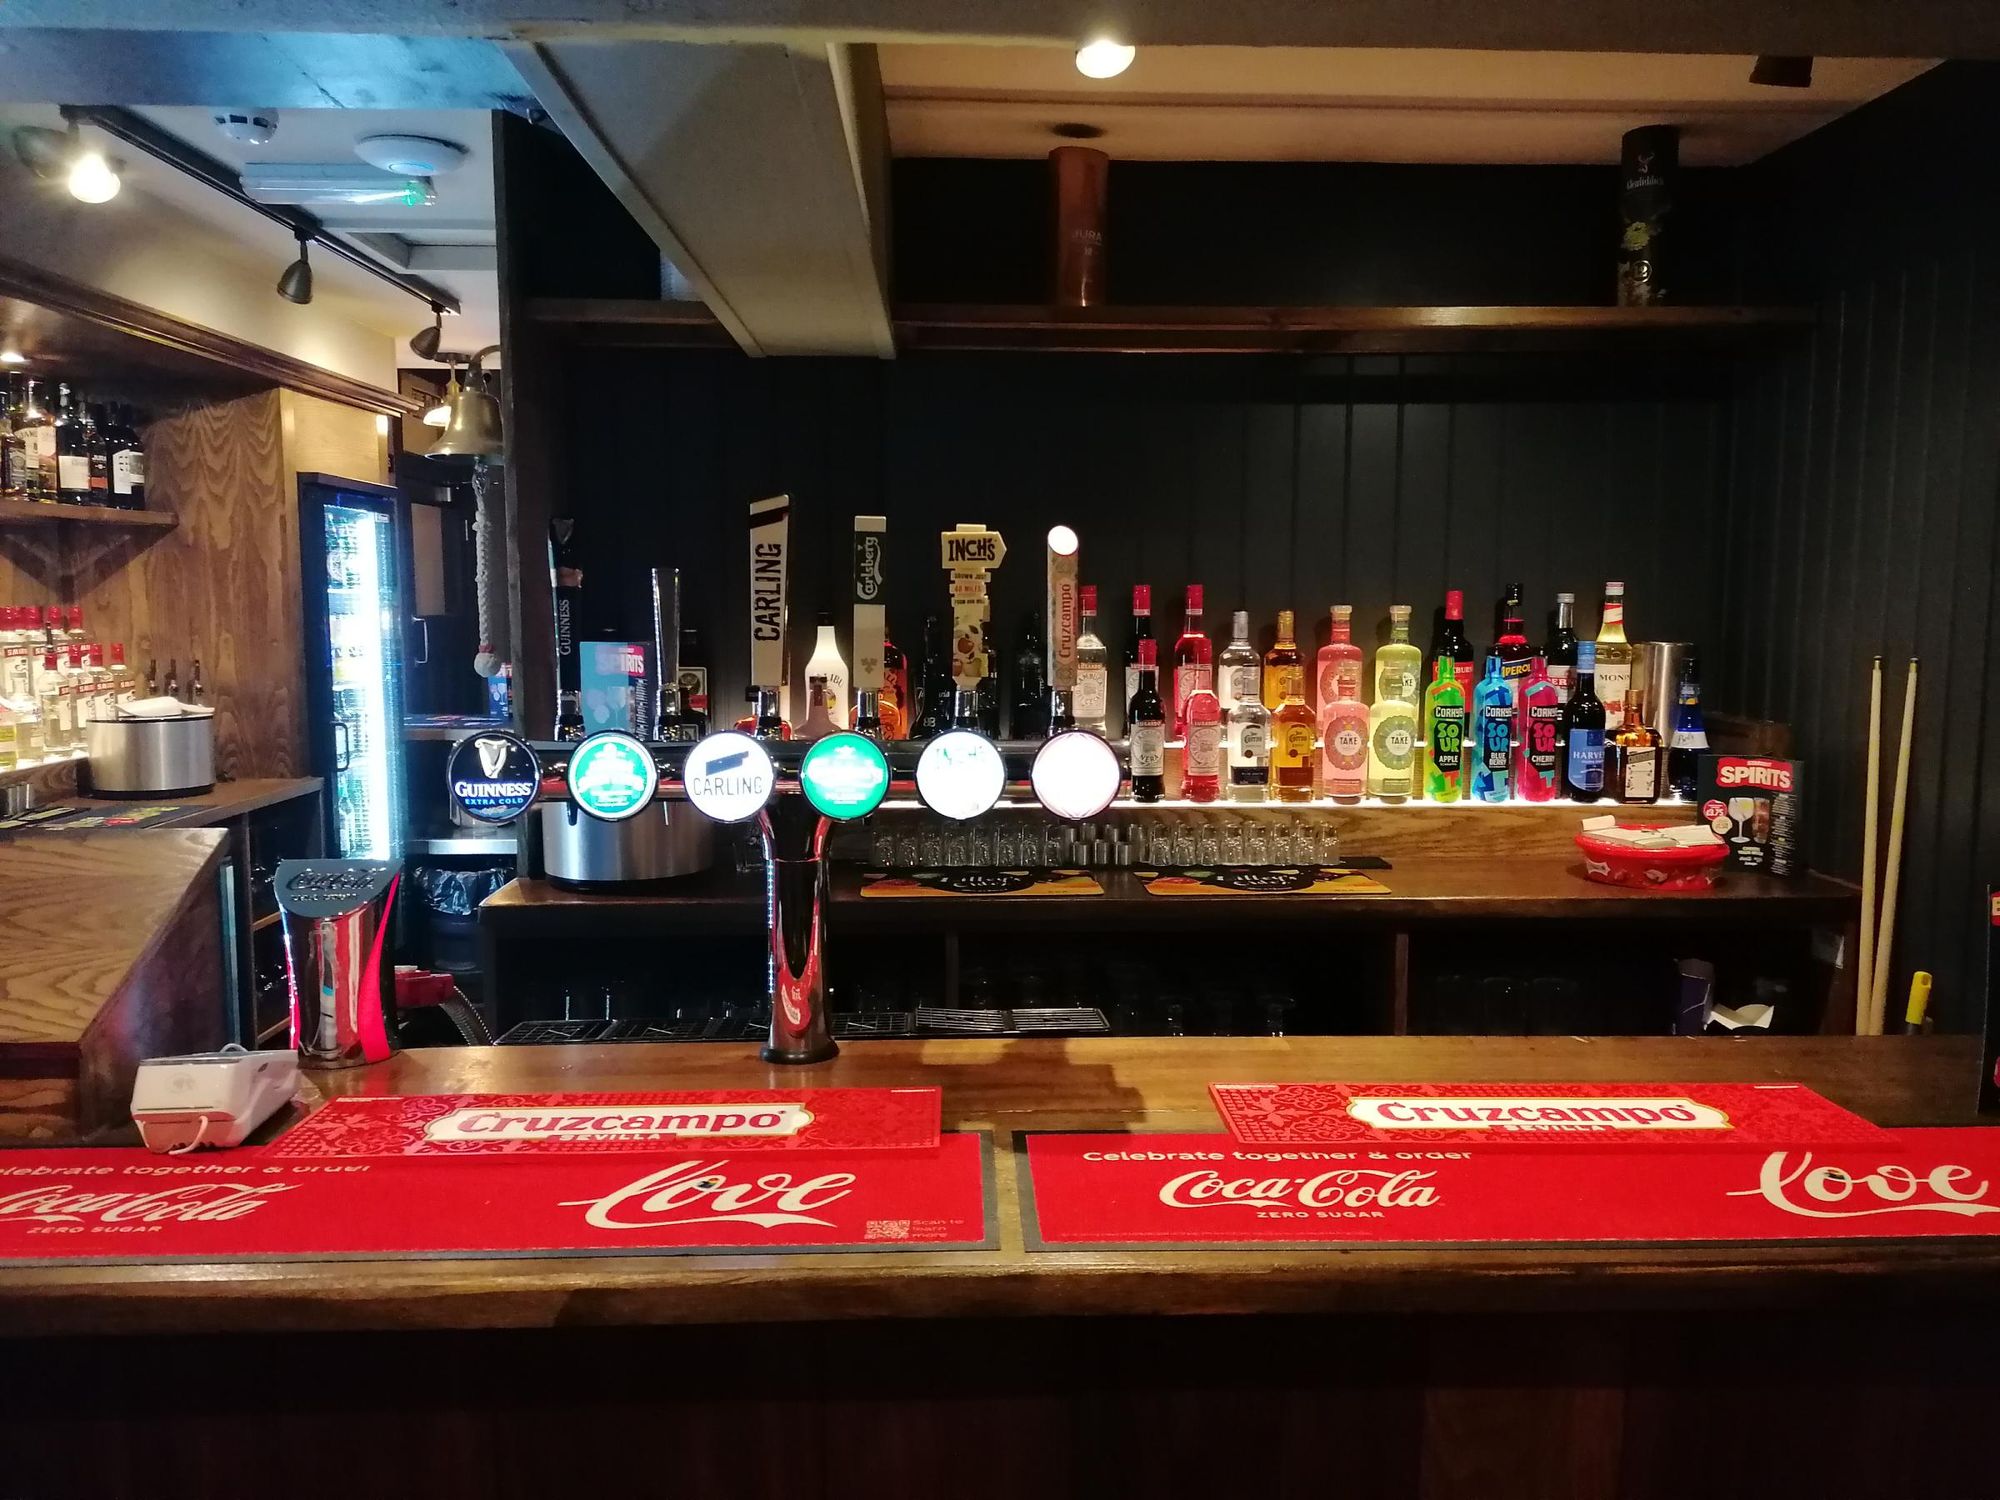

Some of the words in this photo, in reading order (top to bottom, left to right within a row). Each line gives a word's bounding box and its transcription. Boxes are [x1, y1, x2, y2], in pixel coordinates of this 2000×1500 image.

[856, 536, 883, 600] Carlsberg
[754, 543, 781, 642] CARLING
[559, 599, 572, 656] GUINNESS
[1060, 583, 1072, 659] Cruzcampo
[1340, 736, 1358, 746] TAKE
[1391, 736, 1409, 745] TAKE
[1438, 755, 1459, 763] APPLE
[1490, 752, 1506, 760] BLUE
[1720, 766, 1791, 789] SPIRITS
[454, 781, 533, 798] GUINNESS
[693, 776, 763, 796] CARLING
[465, 797, 495, 806] EXTRA
[499, 796, 524, 805] COLD
[1377, 1101, 1697, 1126] Cruzcampo
[459, 1110, 784, 1133] Cruzcampo
[559, 1133, 662, 1141] SEVILLA
[1083, 1151, 1225, 1162] Celebrate
[123, 1164, 256, 1176] together
[1158, 1169, 1442, 1209] Coca-Cola
[1256, 1210, 1309, 1219] ZERO
[1317, 1210, 1386, 1218] SUGAR
[26, 1226, 85, 1235] ZERO
[91, 1225, 163, 1234] SUGAR
